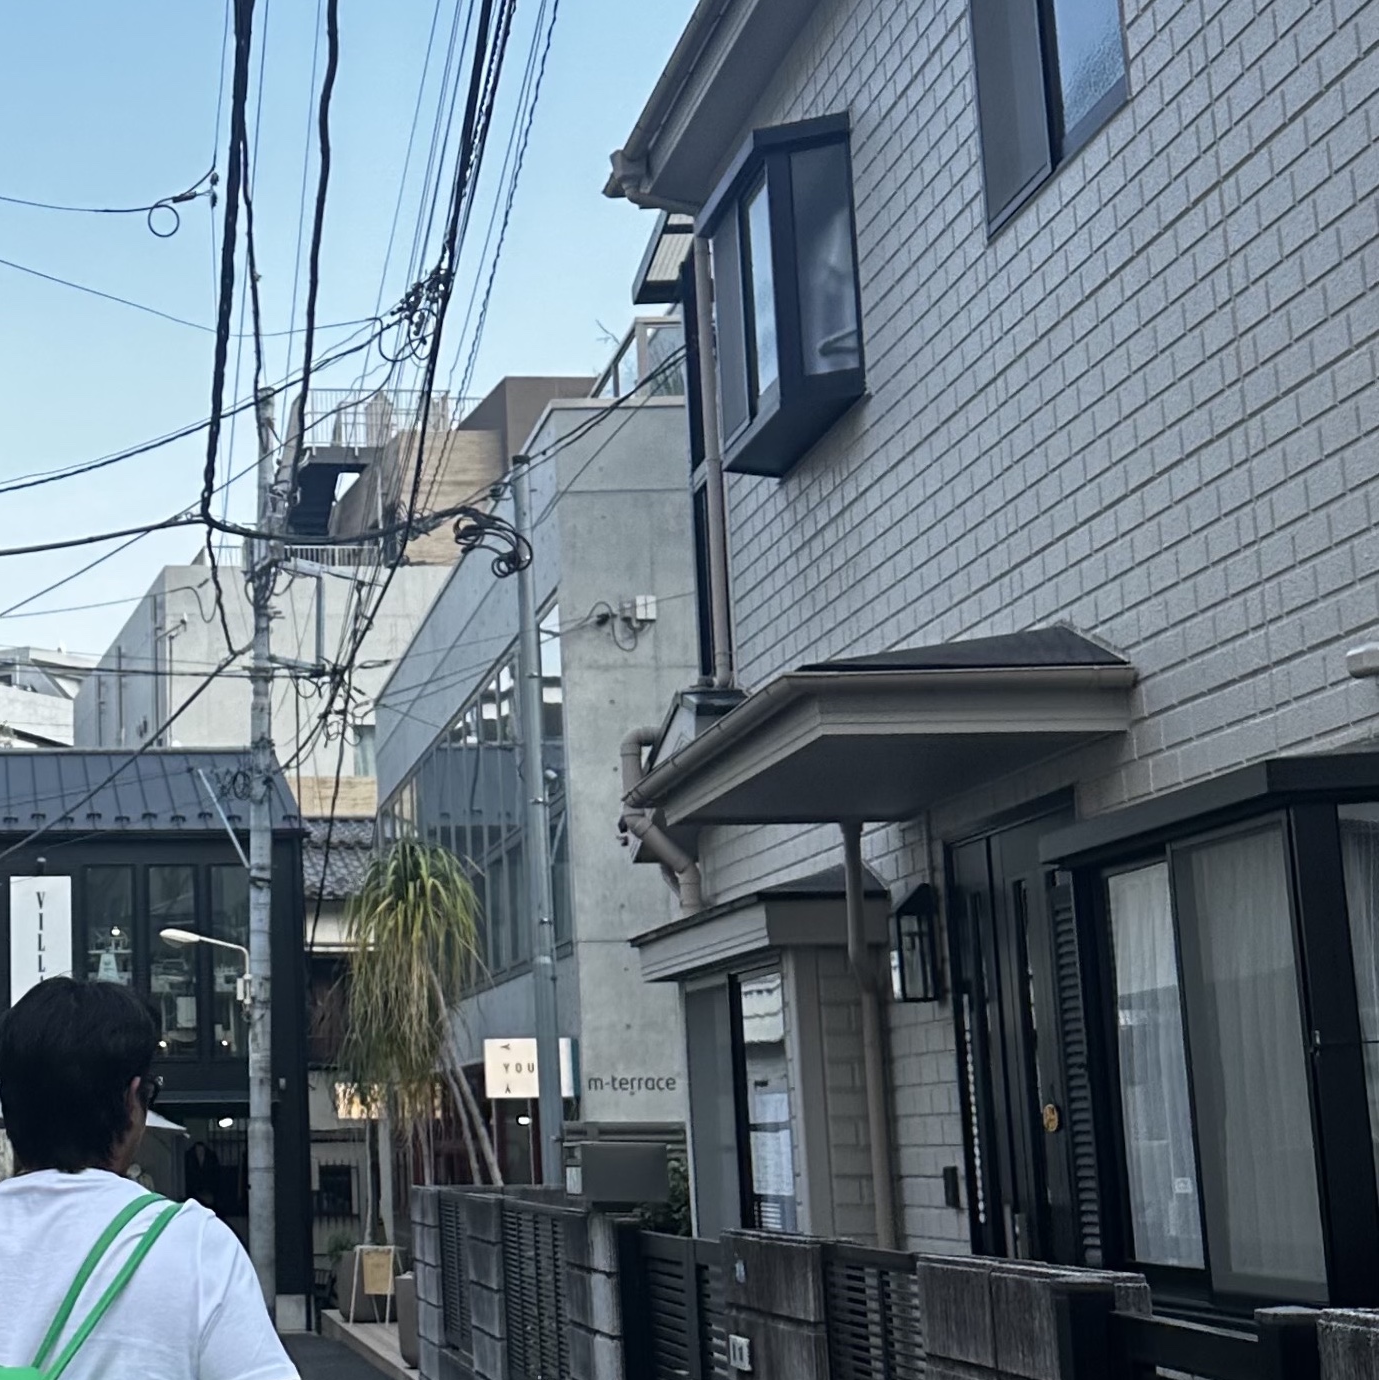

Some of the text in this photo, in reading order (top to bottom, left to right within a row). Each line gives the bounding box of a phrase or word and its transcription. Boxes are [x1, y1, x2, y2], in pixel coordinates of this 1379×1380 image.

[36, 891, 46, 981] VILL
[503, 1063, 535, 1074] YOU
[588, 1075, 677, 1091] m-terrace
